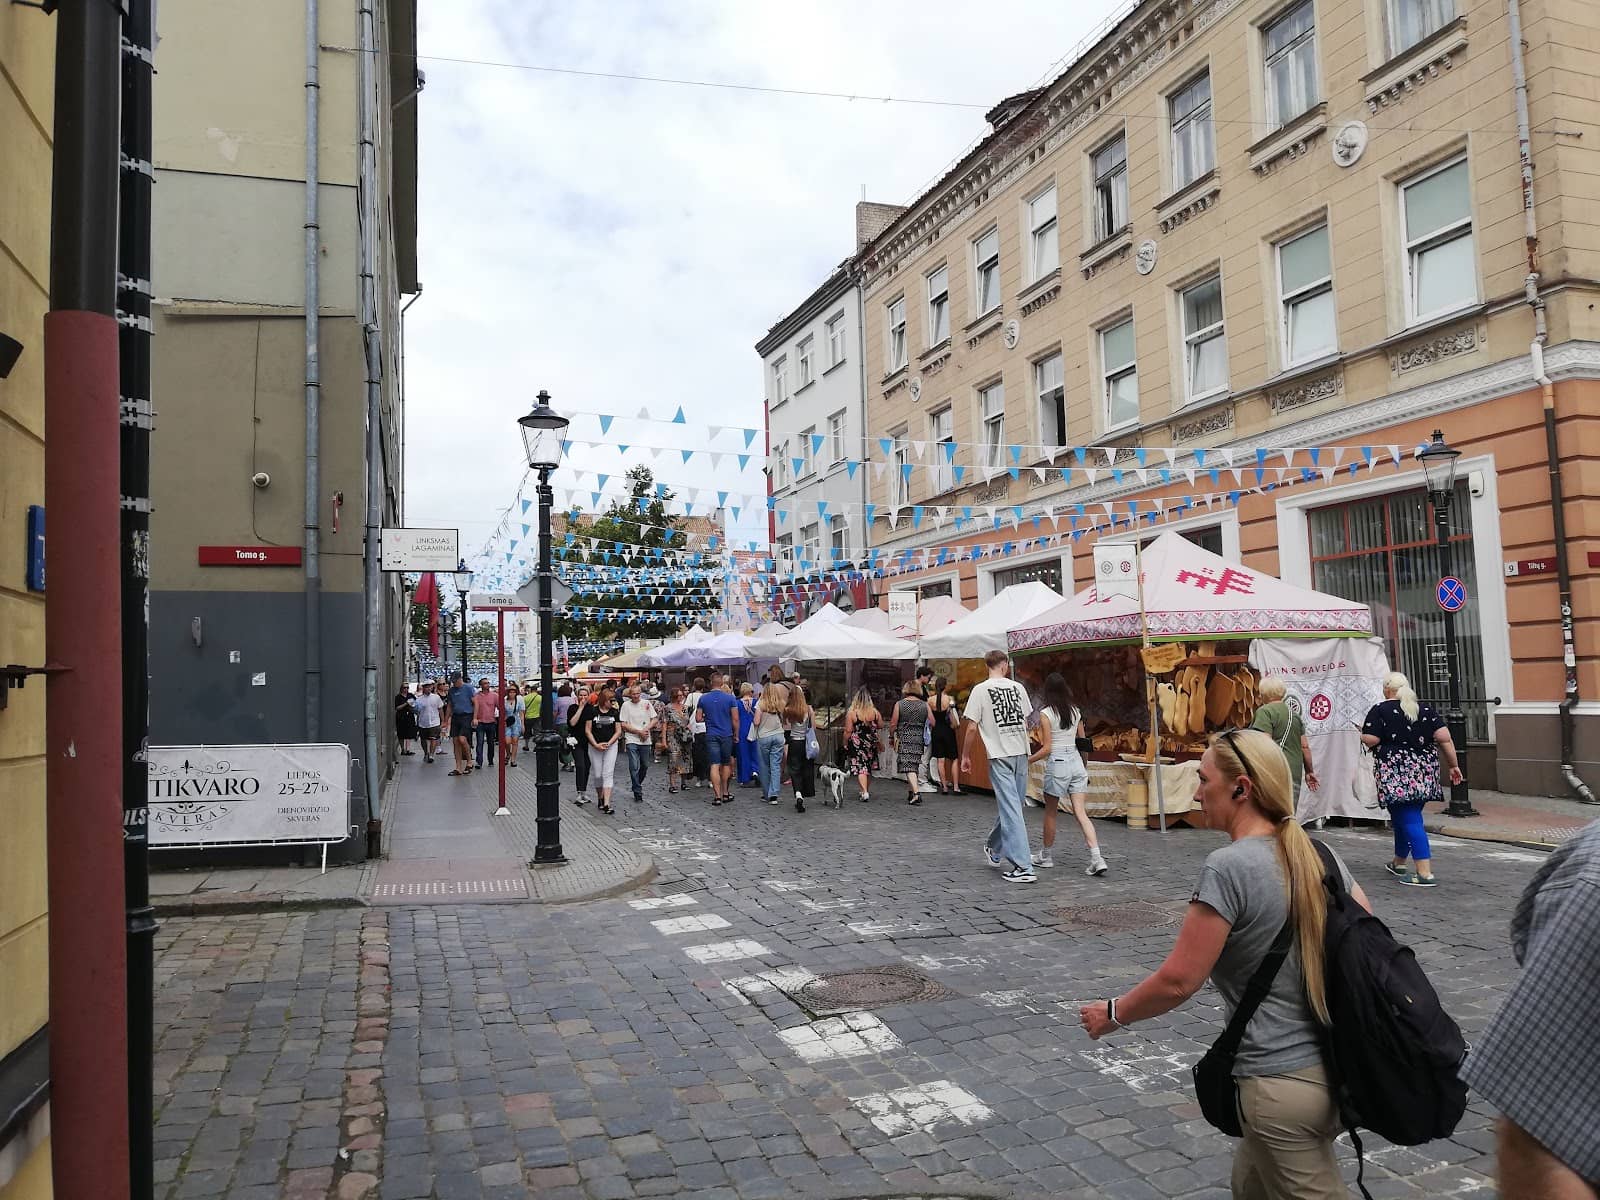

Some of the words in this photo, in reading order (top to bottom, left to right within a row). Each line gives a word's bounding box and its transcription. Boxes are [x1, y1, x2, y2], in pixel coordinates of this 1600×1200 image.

[411, 544, 455, 552] LAGAMINAS
[235, 550, 258, 559] Tomo
[259, 552, 267, 561] g.
[488, 596, 507, 604] Tomo
[287, 771, 321, 780] LIEPOS
[149, 777, 260, 796] TIKVARO
[287, 815, 321, 823] SKVERAS
